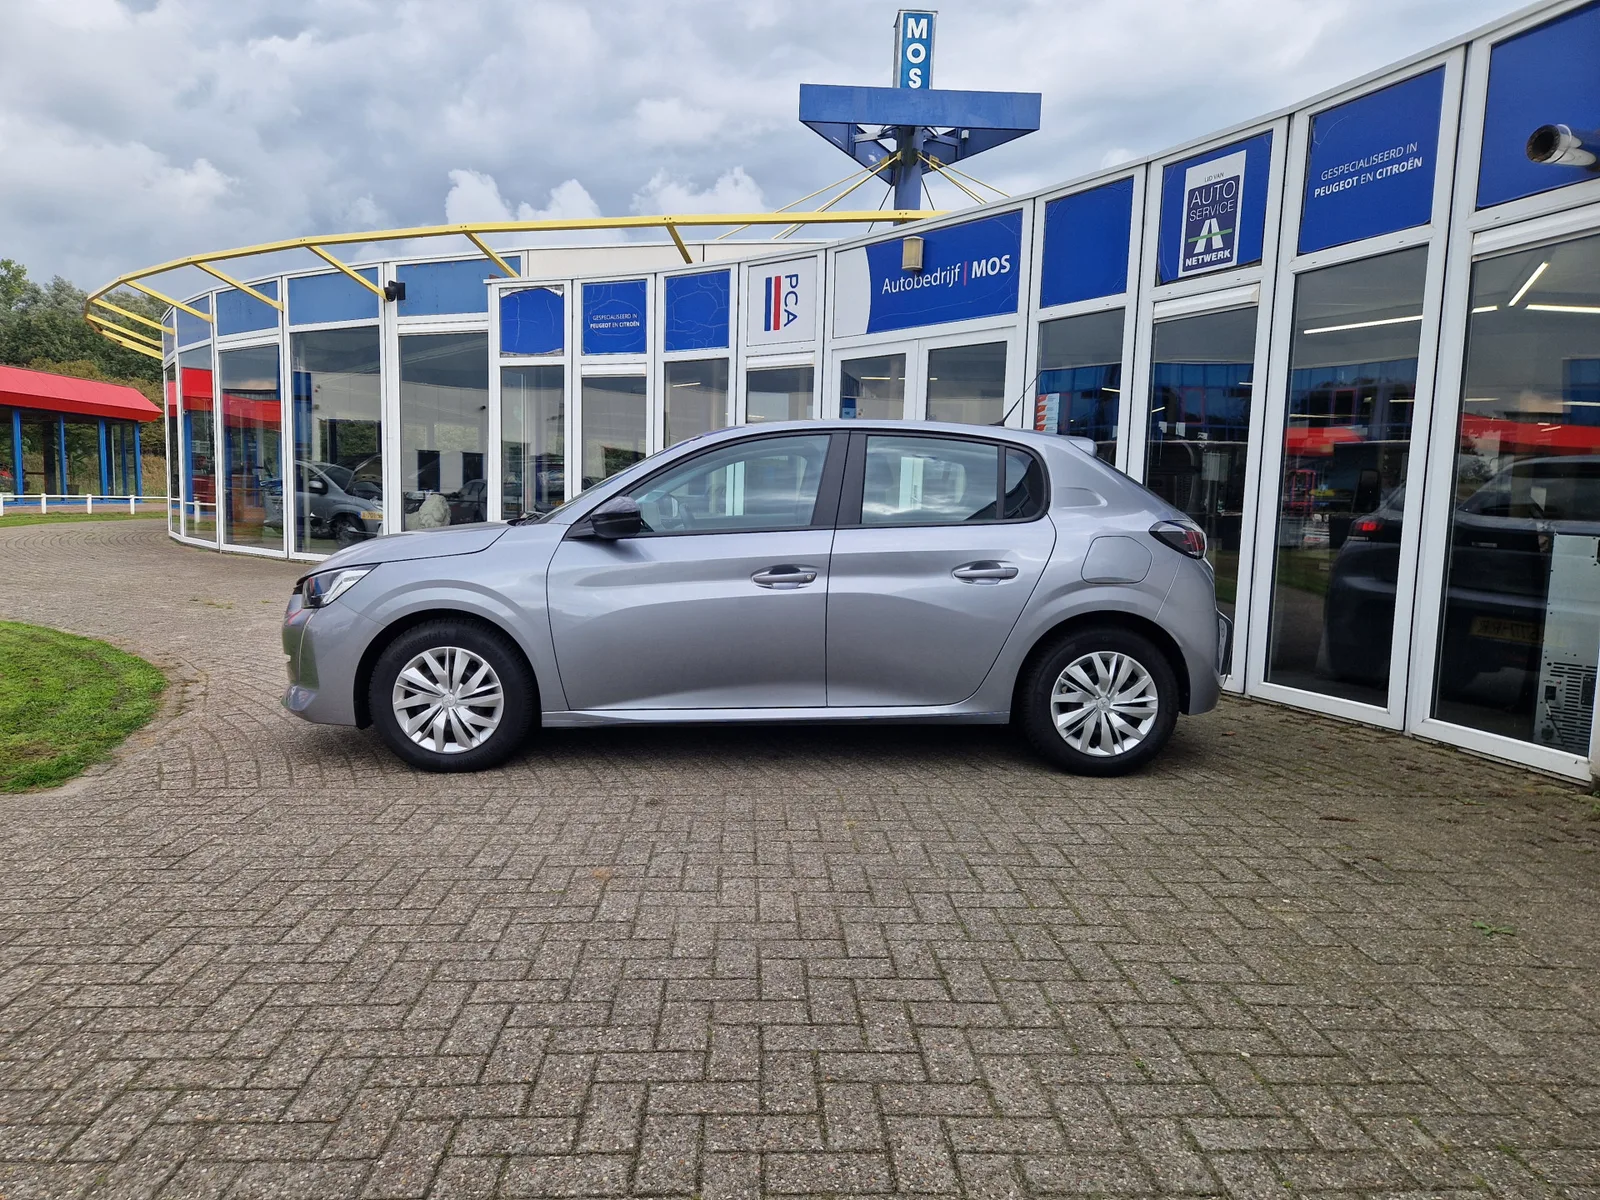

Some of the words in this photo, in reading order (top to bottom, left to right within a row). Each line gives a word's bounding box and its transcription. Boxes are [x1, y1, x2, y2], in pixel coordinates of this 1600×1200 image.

[907, 18, 928, 89] MOS
[1314, 177, 1359, 198] PEUGEOT
[1360, 171, 1374, 184] EN
[1376, 157, 1423, 180] CITROËN
[1321, 146, 1404, 181] GESPECIALISEERD
[1406, 142, 1418, 155] IN
[1189, 199, 1235, 222] SERVICE
[1190, 180, 1236, 208] AUTO
[882, 263, 961, 294] Autobedrijf
[971, 254, 1011, 279] MOS
[1185, 248, 1231, 267] NETWERK
[783, 273, 799, 327] PCA
